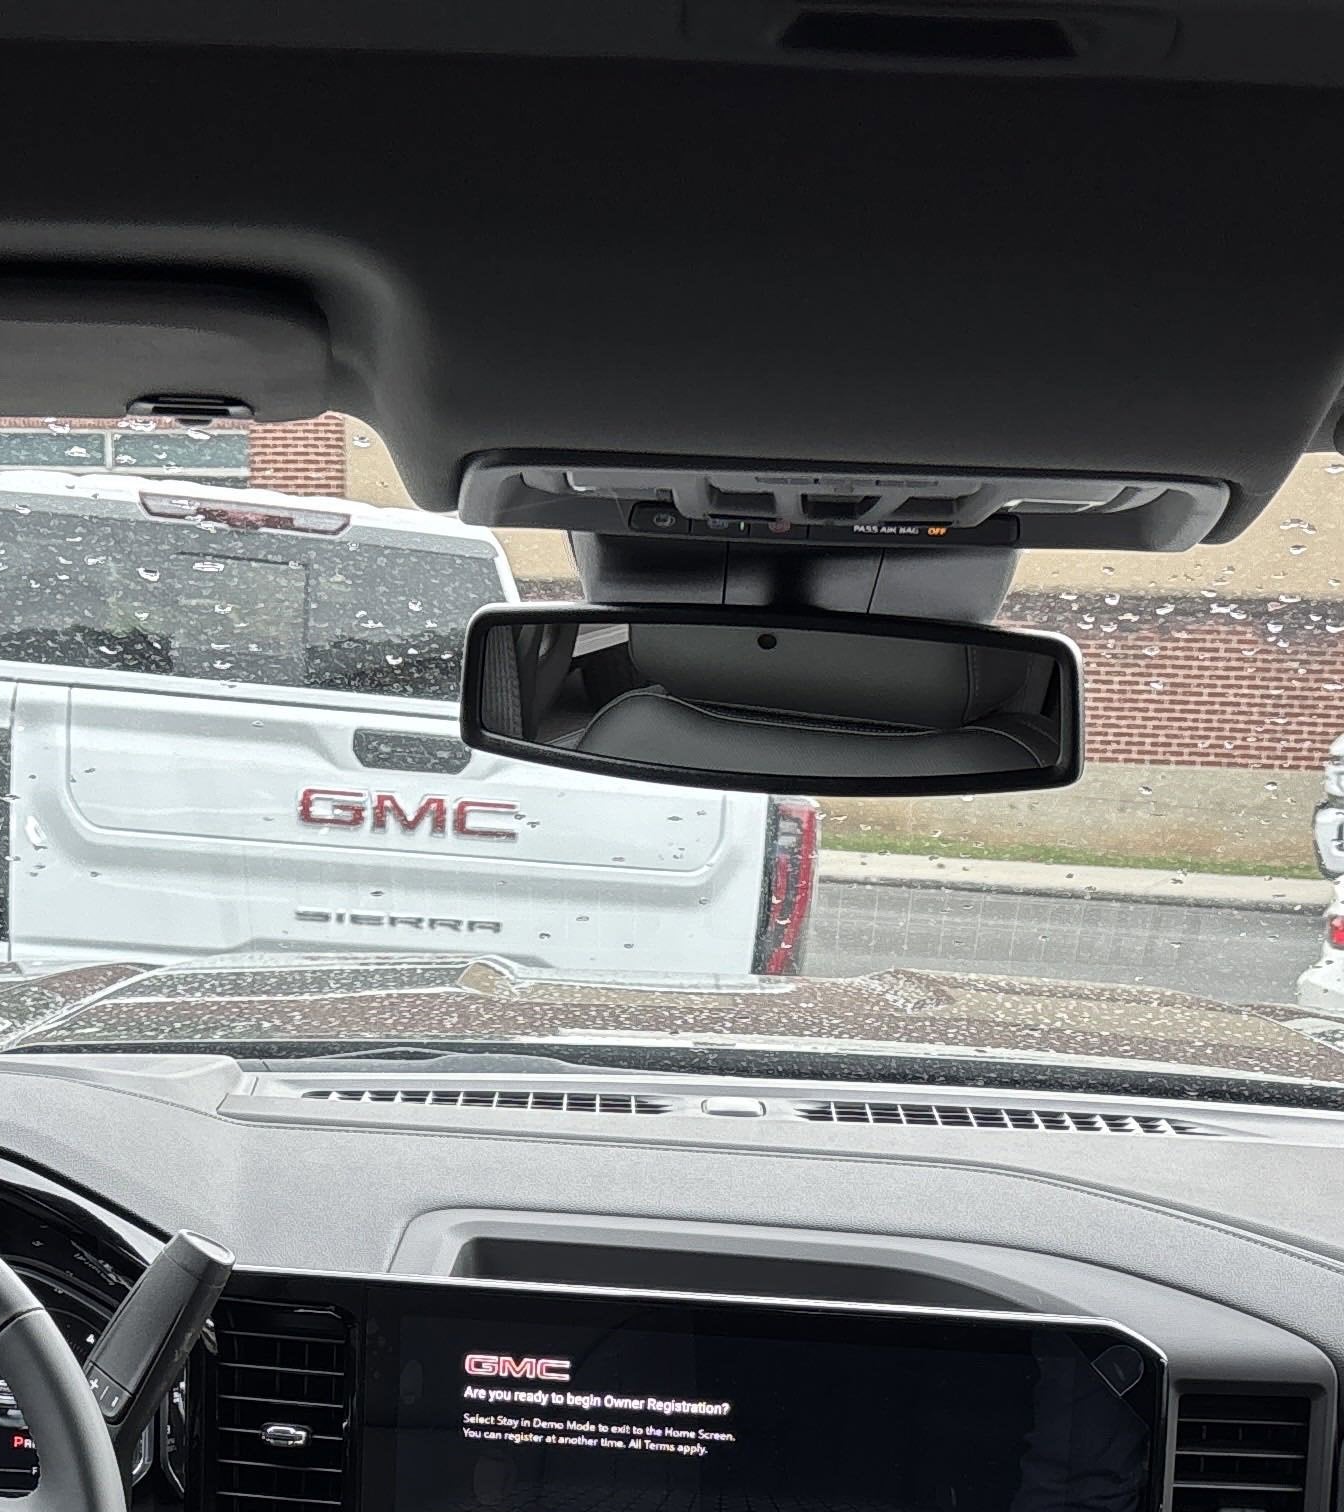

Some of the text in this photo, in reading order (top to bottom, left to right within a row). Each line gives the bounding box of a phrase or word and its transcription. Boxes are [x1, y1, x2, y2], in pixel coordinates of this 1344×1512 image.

[928, 527, 947, 535] OFF
[297, 787, 519, 842] GMC
[294, 909, 502, 934] SIERRA
[464, 1353, 571, 1381] GMC
[464, 1386, 730, 1416] Are you ready to begin Owner Registration?
[464, 1414, 736, 1442] Select Stay in Demo Mode to exit to the Home Screen.
[463, 1428, 708, 1457] You can register at another time. All Terms apply.
